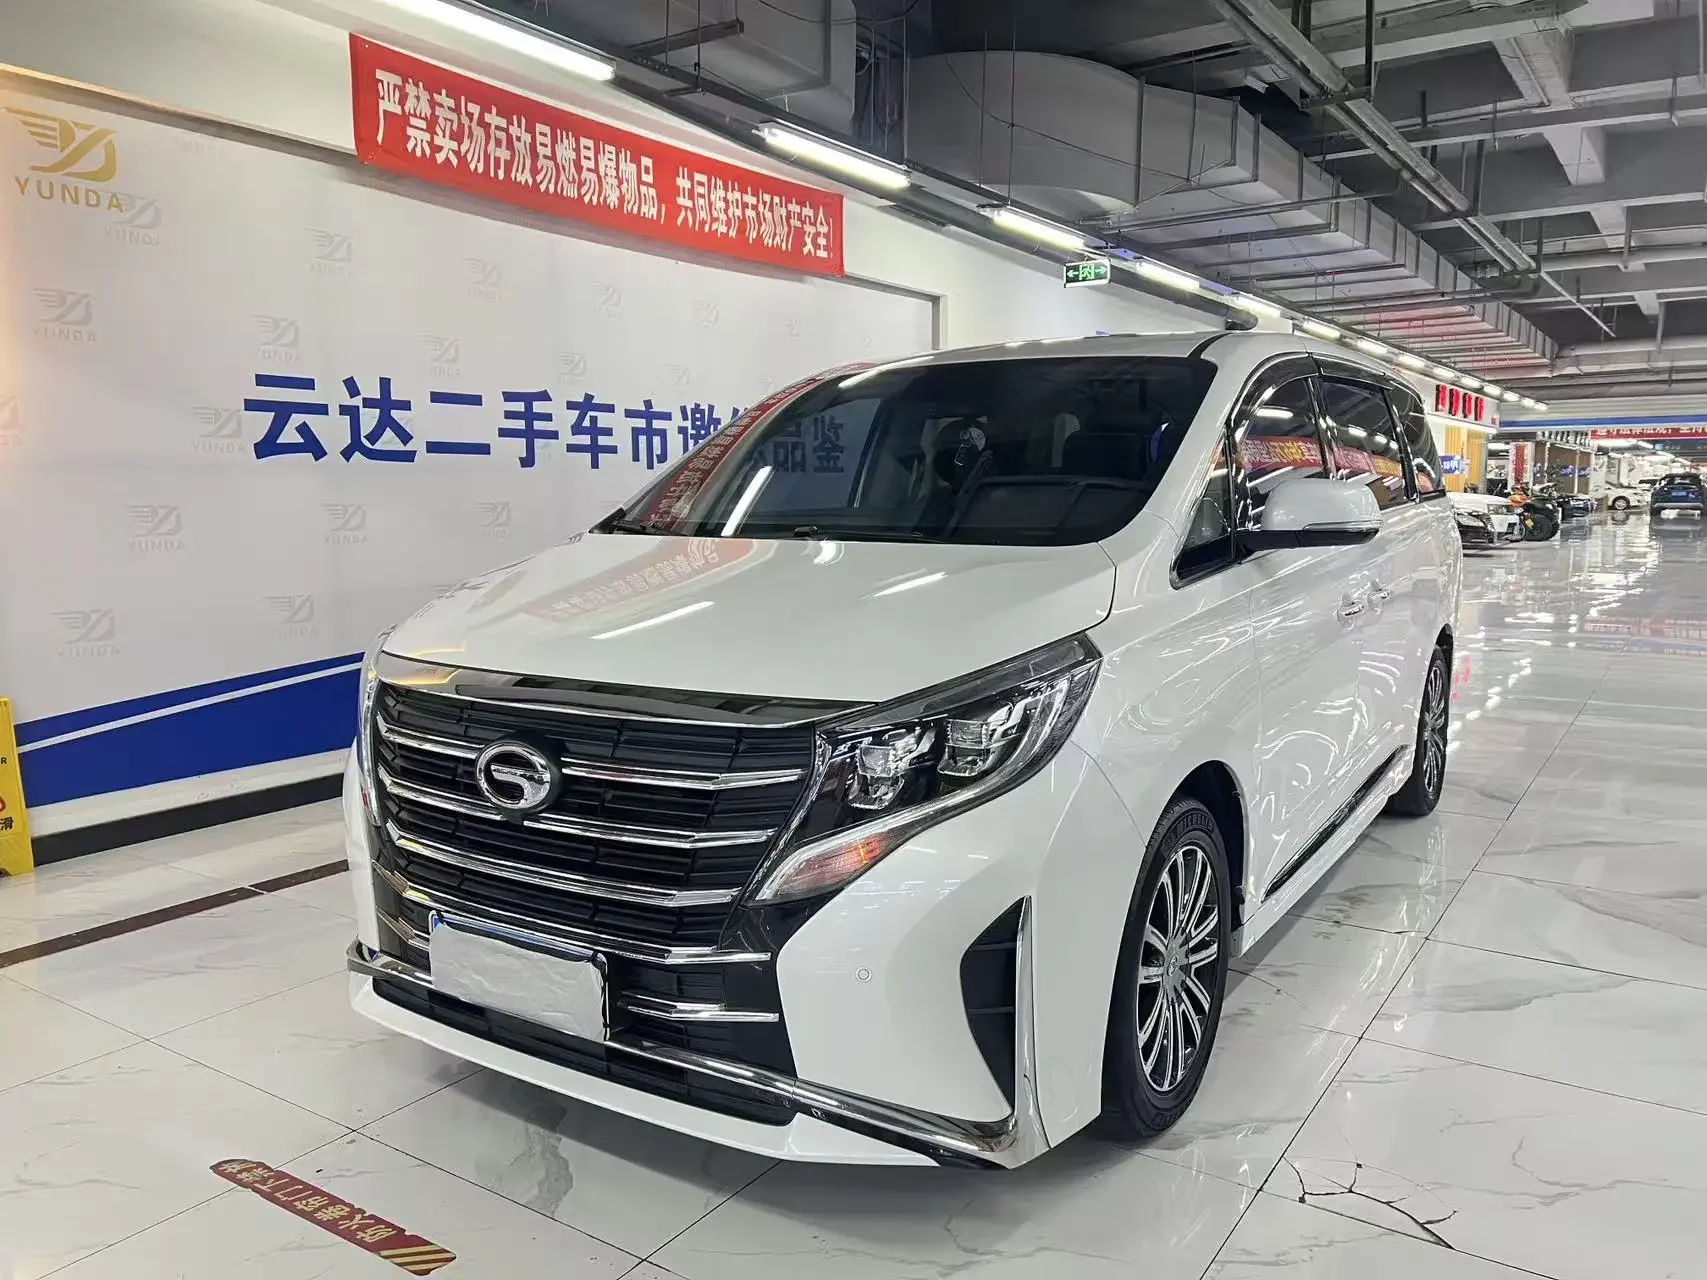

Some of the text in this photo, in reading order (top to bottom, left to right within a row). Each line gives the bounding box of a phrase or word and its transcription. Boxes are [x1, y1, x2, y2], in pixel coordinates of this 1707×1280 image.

[14, 176, 124, 213] YUNDA
[31, 326, 97, 343] YUNDA
[243, 373, 845, 473] 云达二手车市邀品鉴
[192, 440, 248, 454] YUNDA
[126, 539, 186, 553] YUNDA
[322, 533, 369, 545] YUNDA
